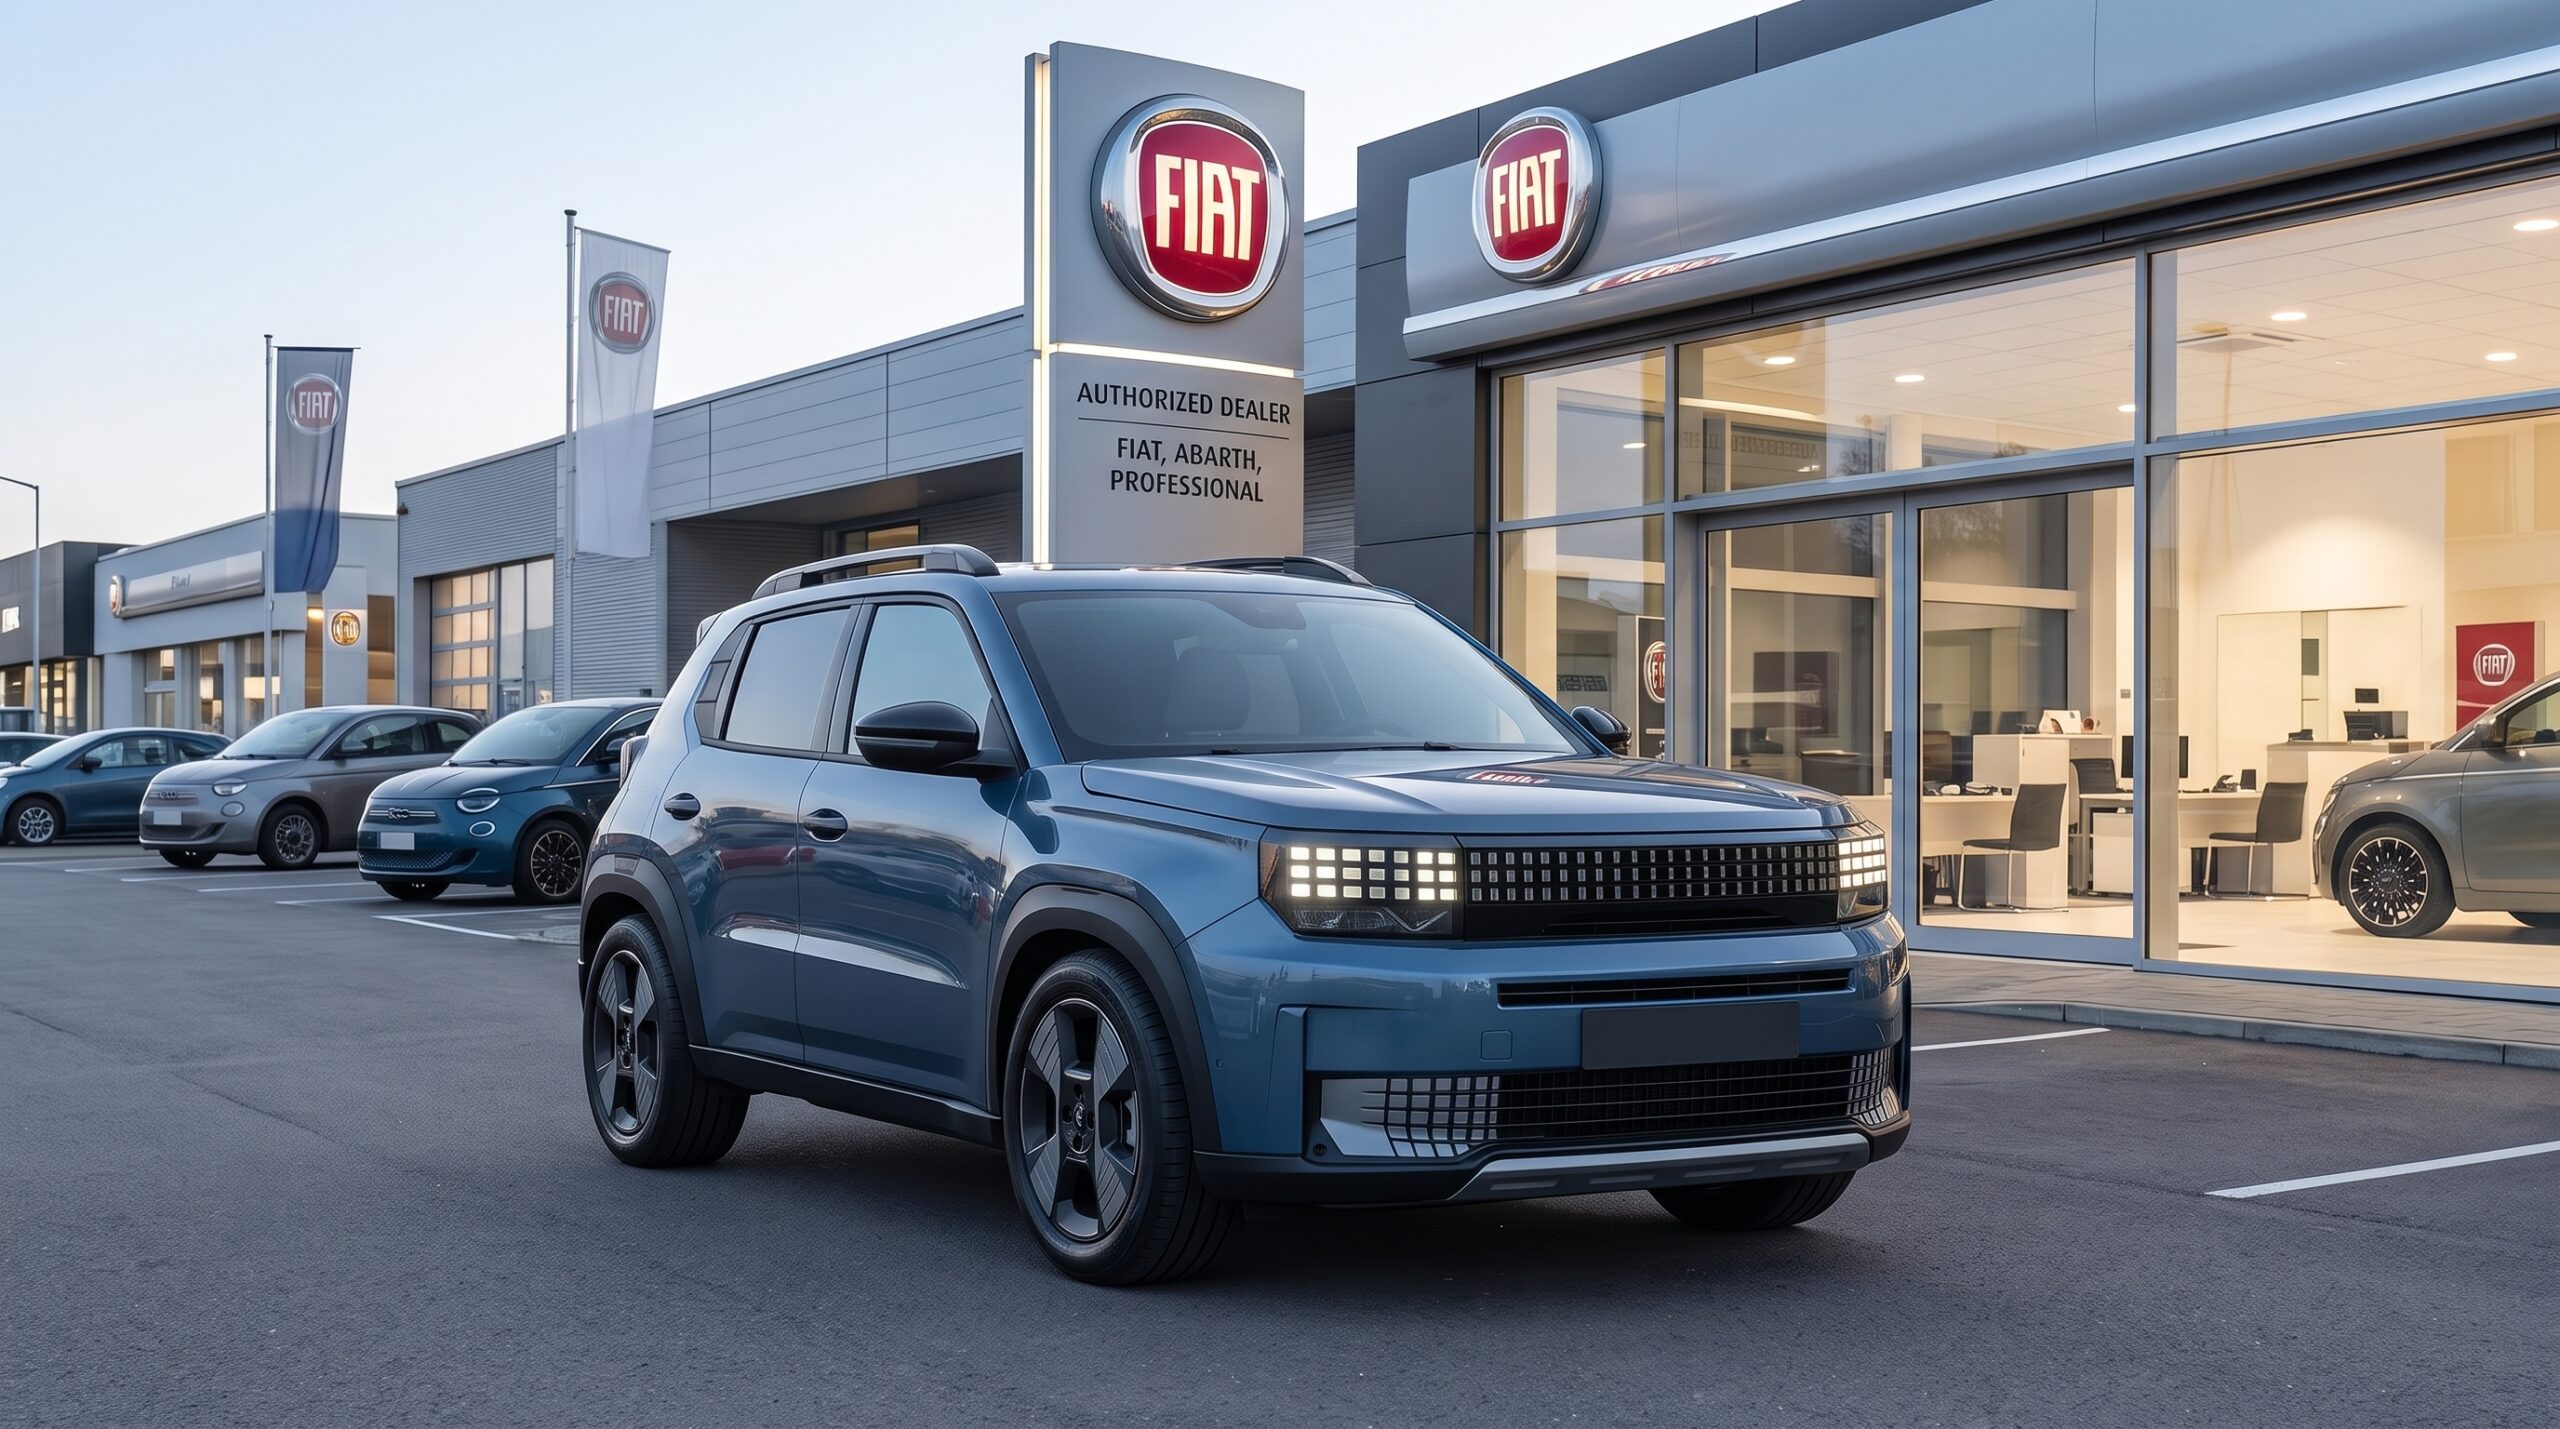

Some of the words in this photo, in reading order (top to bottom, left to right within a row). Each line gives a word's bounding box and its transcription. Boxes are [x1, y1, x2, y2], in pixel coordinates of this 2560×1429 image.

[1155, 153, 1260, 261] FIAT
[1492, 148, 1561, 238] FIAT
[604, 294, 644, 334] FIAT
[299, 391, 332, 419] FIAT
[1077, 382, 1213, 415] AUTHORIZED
[1221, 396, 1291, 425] DEALER
[1117, 437, 1166, 467] FIAT,
[1174, 443, 1262, 475] ABARTH,
[1111, 469, 1264, 502] PROFESSIONAL
[2482, 654, 2508, 675] FIAT
